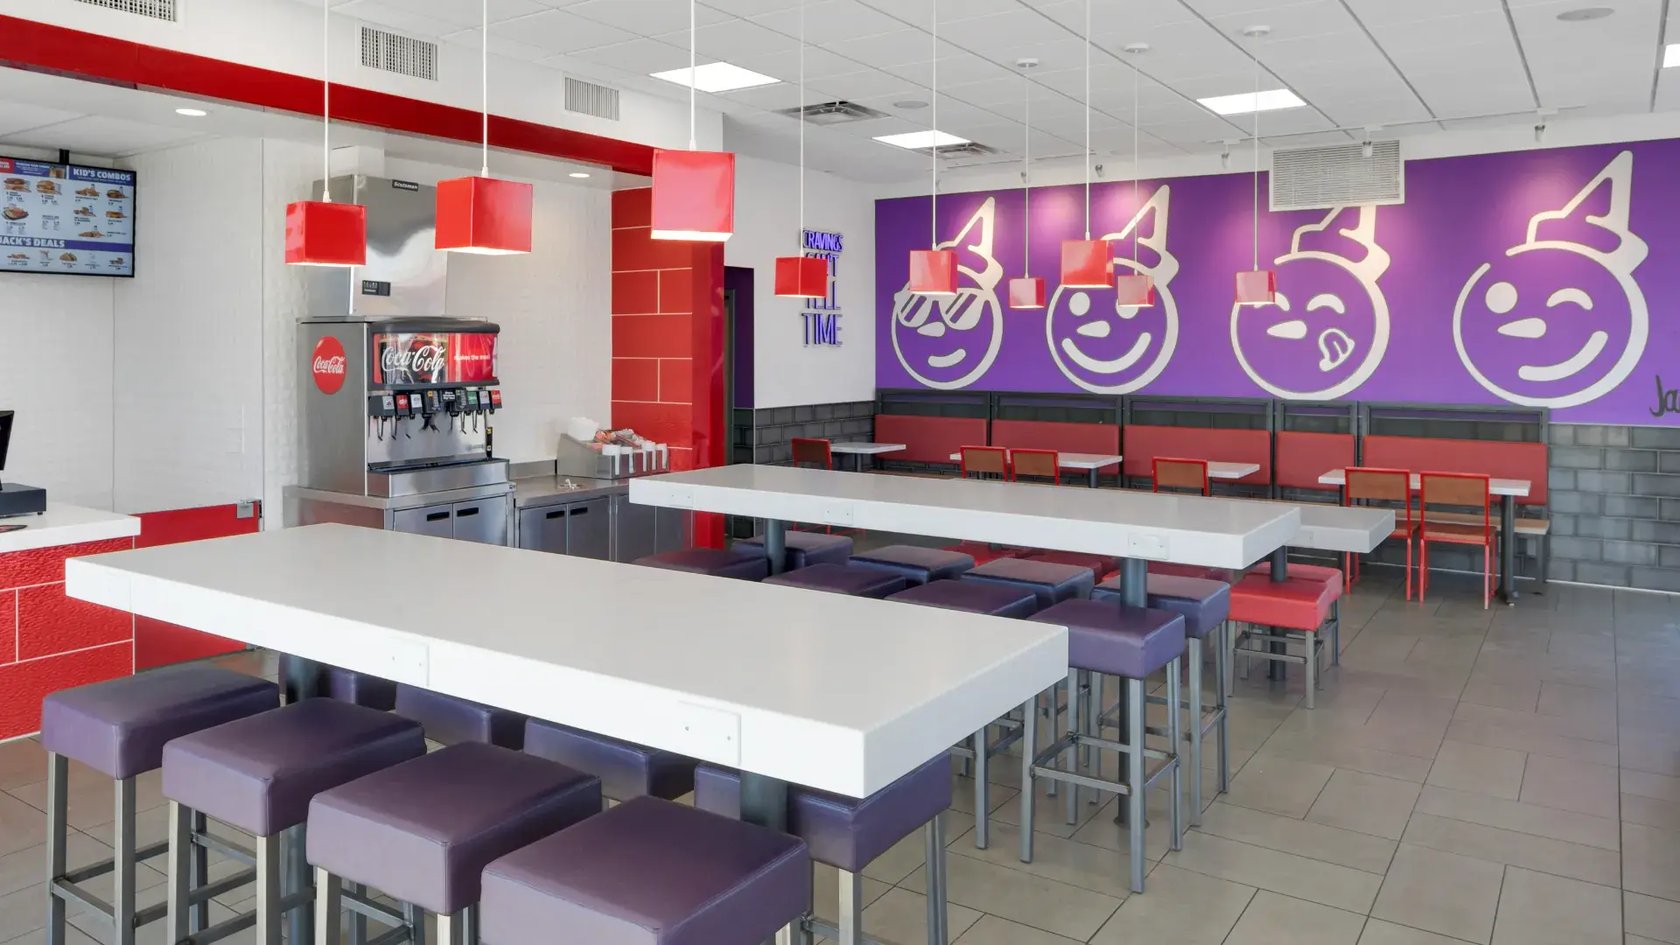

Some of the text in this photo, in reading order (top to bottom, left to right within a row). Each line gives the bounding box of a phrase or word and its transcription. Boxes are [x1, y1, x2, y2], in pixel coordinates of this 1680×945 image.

[73, 168, 95, 177] KID'S
[97, 171, 131, 181] COMBOS
[33, 238, 65, 248] DEALS
[802, 229, 842, 252] CRAVINGS
[801, 312, 842, 347] TIME
[313, 355, 345, 374] Coca-Cola
[382, 345, 446, 384] Coca-Cola
